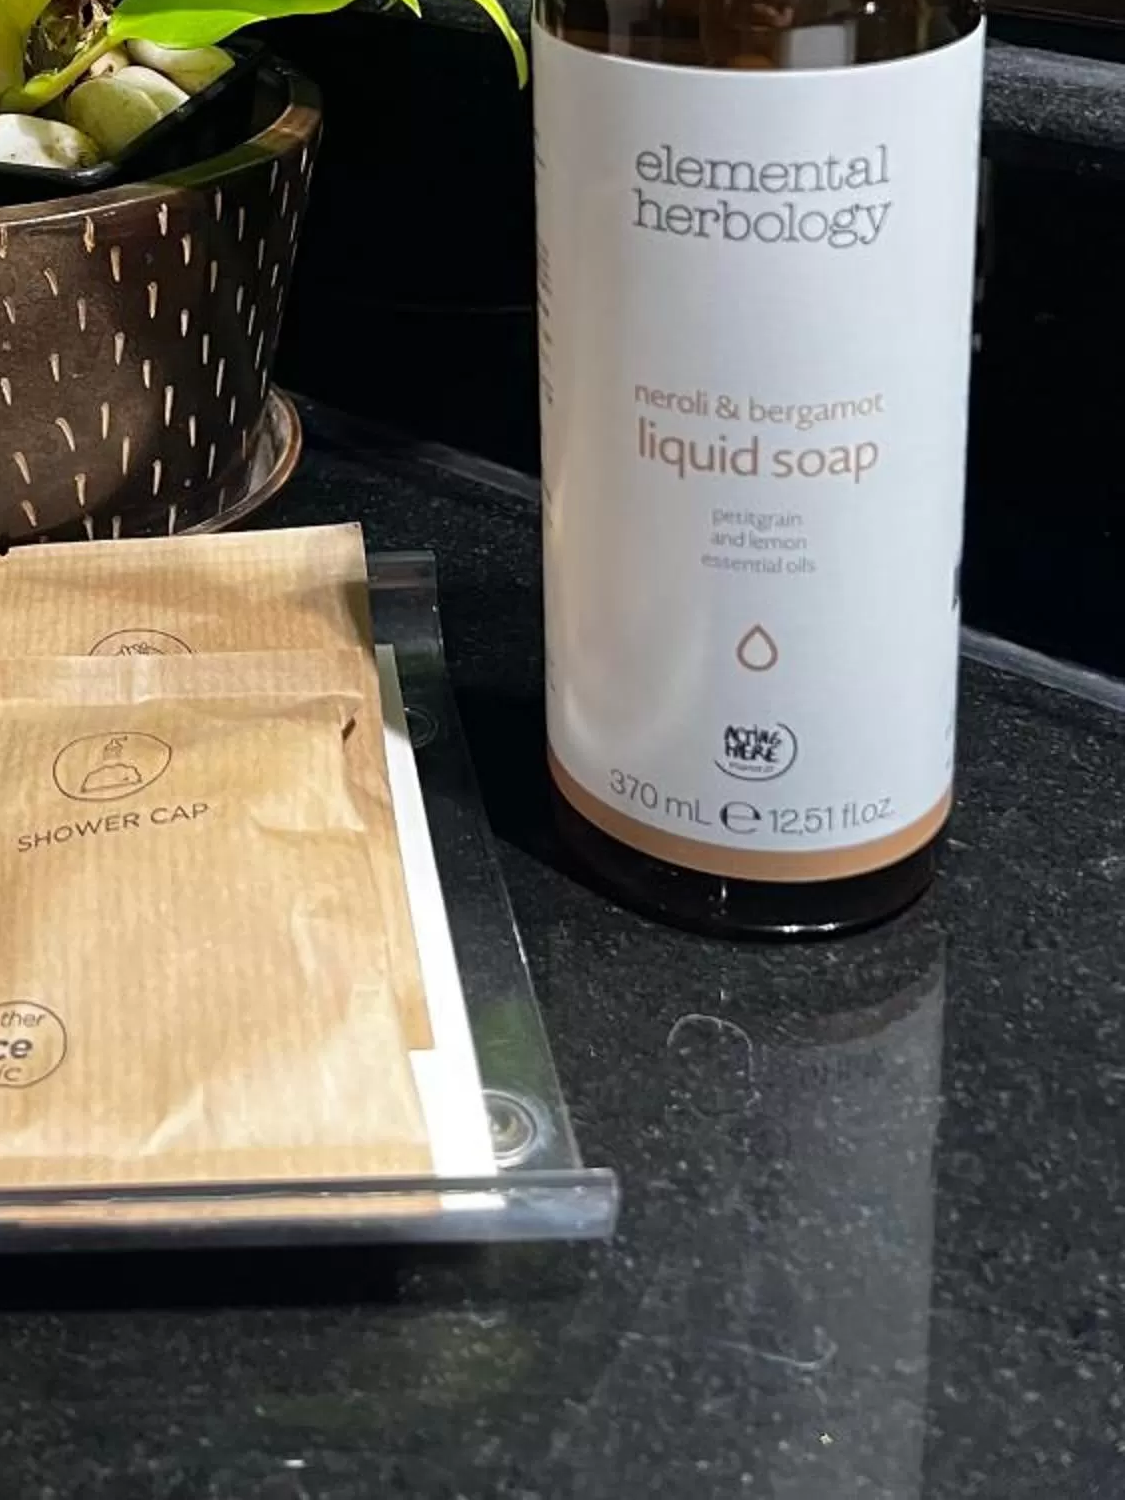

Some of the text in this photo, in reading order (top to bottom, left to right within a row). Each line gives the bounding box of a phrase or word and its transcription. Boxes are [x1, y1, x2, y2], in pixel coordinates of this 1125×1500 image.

[635, 143, 891, 194] elemental
[632, 187, 892, 249] herbology
[634, 383, 885, 431] neroli & bergamot
[638, 416, 879, 485] liquid soap
[609, 768, 658, 810] 370
[665, 797, 712, 826] mL
[17, 803, 209, 853] SHOWER CAP
